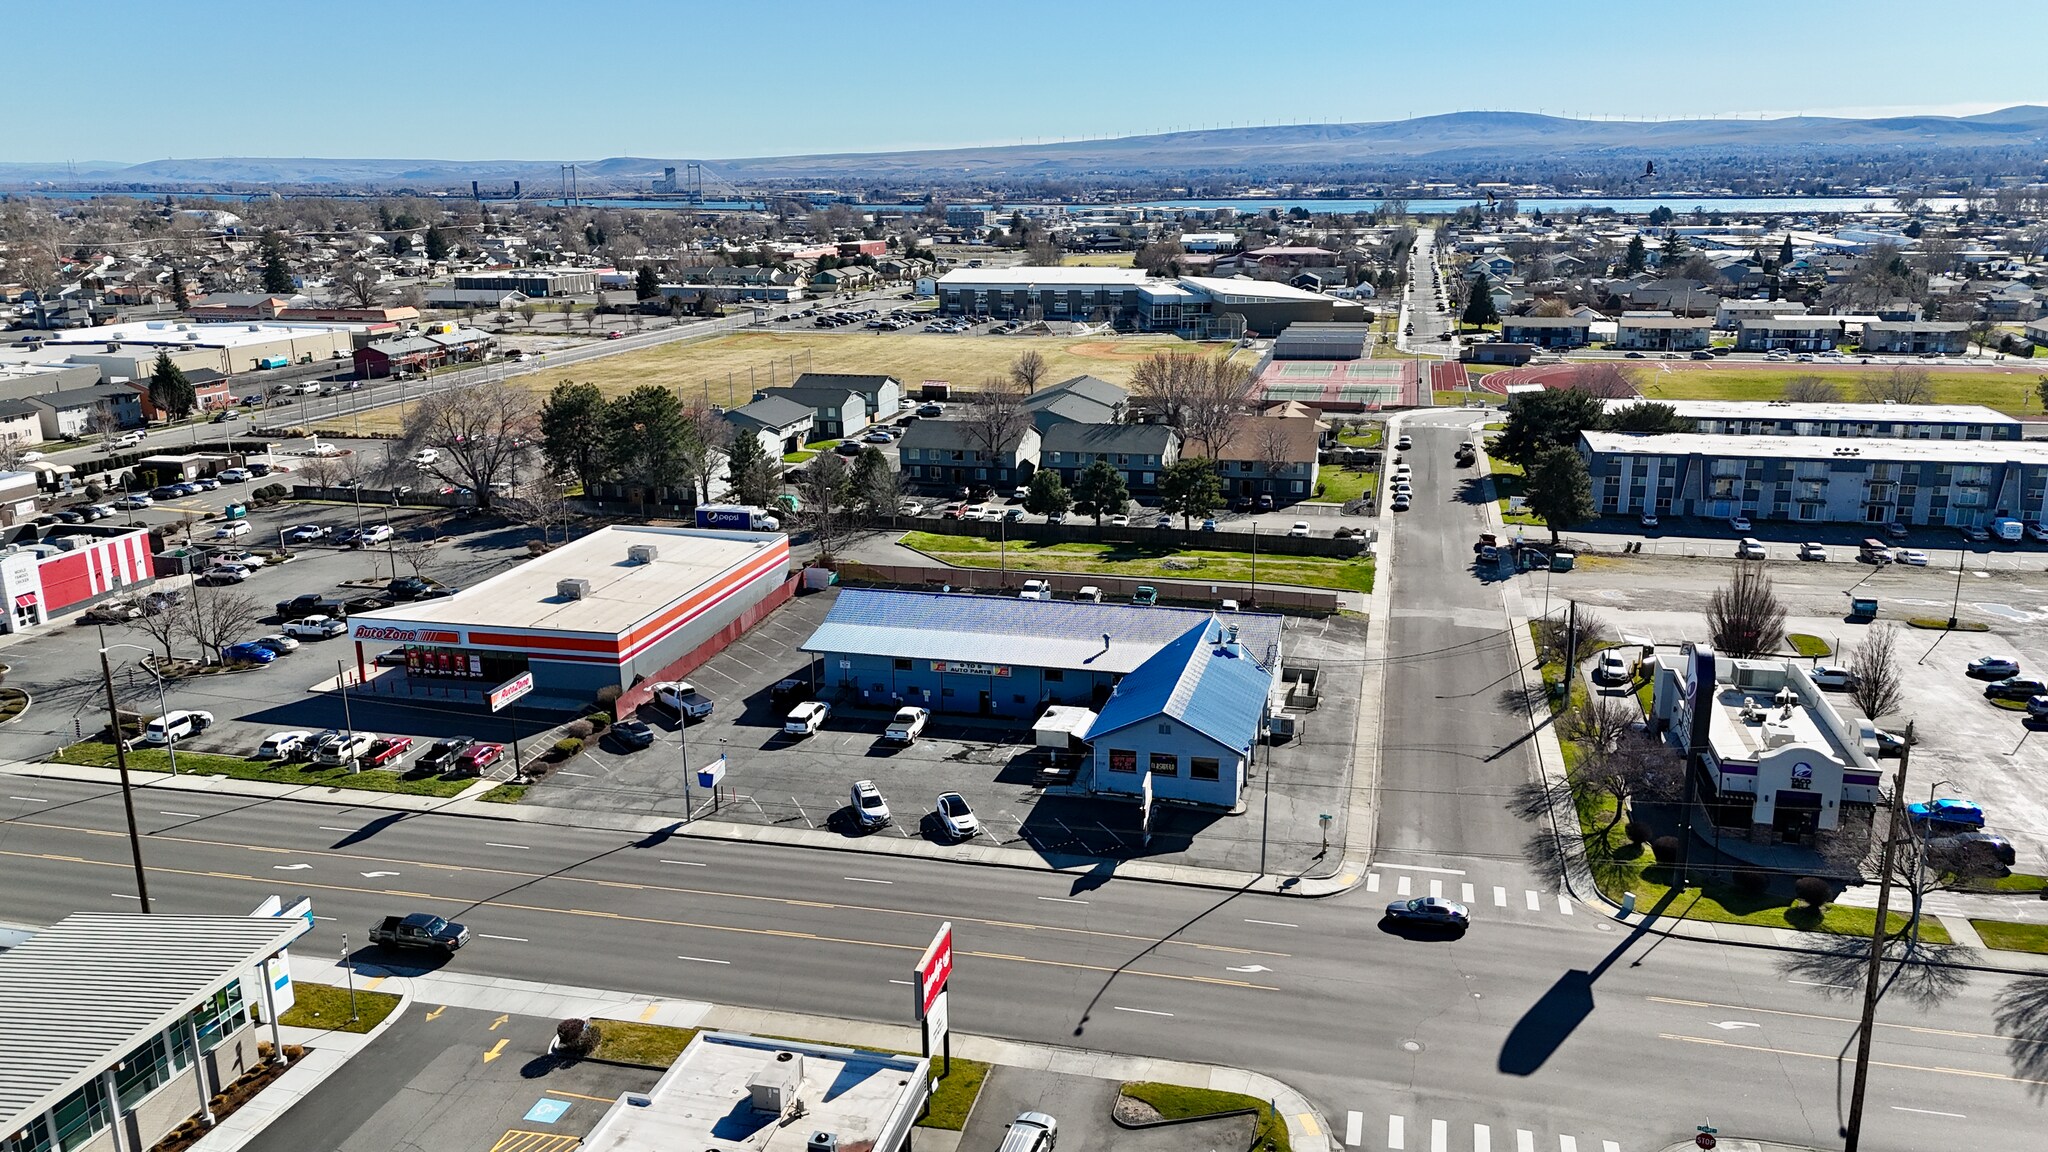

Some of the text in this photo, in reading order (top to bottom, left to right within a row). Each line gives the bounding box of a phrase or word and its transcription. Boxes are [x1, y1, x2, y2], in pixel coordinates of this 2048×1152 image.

[719, 514, 739, 522] pepsi
[355, 625, 415, 641] AutoZone
[1697, 1137, 1715, 1146] STOP
